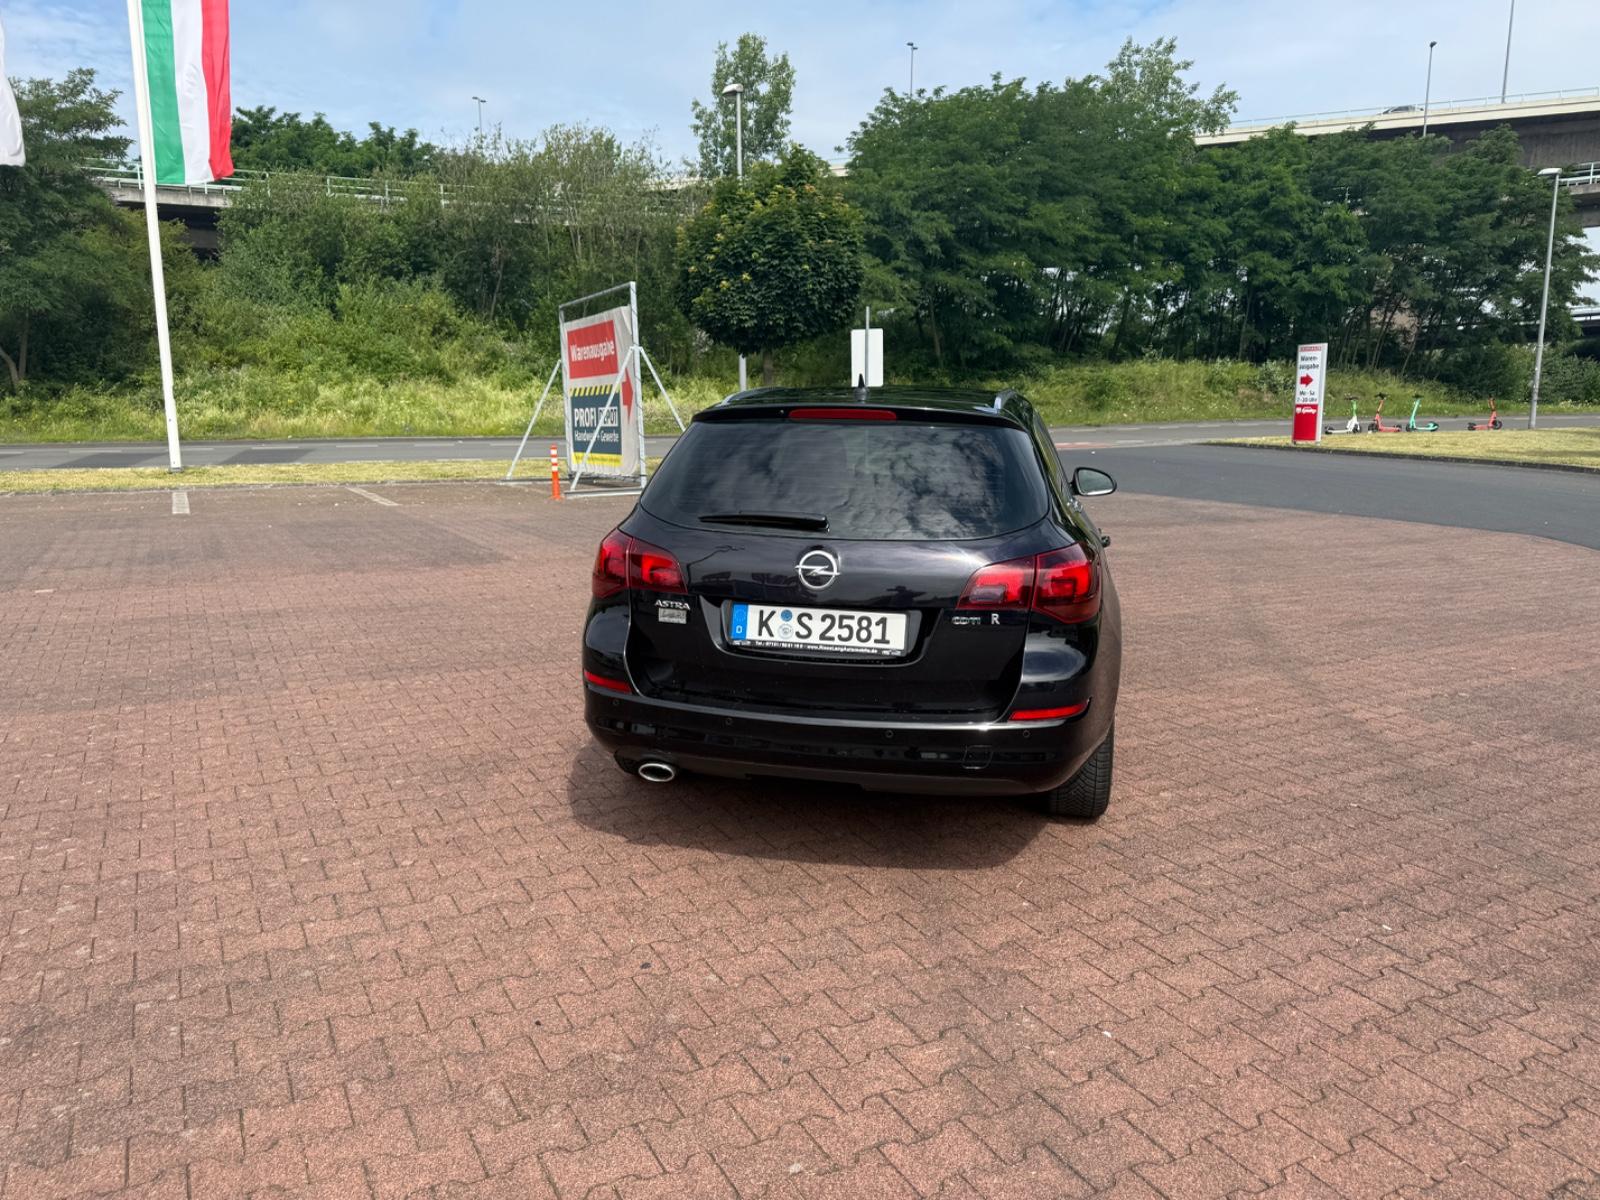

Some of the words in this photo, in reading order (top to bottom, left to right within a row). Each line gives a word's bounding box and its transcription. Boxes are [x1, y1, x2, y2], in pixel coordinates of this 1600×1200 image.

[570, 338, 615, 362] Warenausgabe
[574, 407, 597, 427] PROFI
[655, 599, 691, 610] ASTRA
[735, 625, 743, 634] D
[758, 609, 776, 637] K
[795, 612, 813, 639] S
[819, 613, 890, 645] 2581
